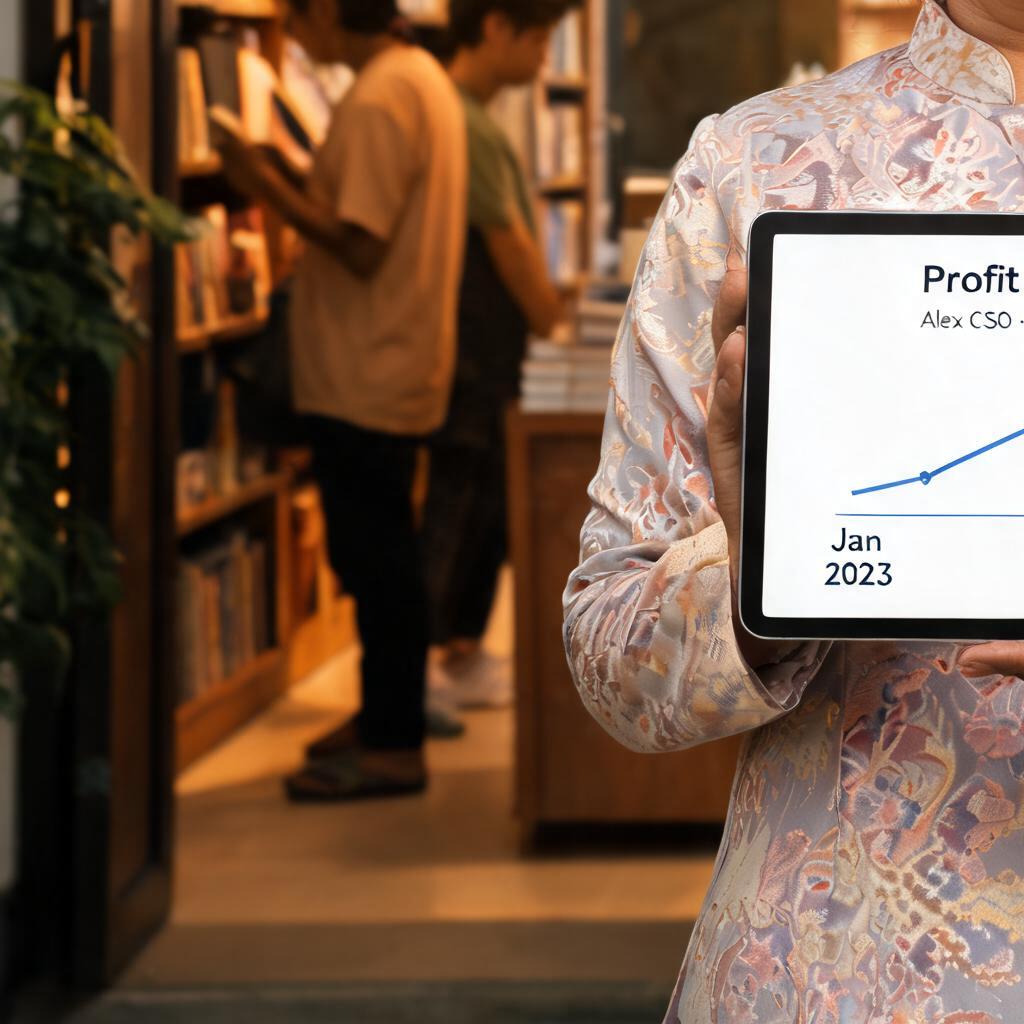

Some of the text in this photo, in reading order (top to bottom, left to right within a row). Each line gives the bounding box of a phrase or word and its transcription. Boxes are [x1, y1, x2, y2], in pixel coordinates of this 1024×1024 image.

[923, 264, 1020, 294] Profit
[920, 309, 963, 329] Alex
[969, 310, 1012, 330] CSO
[831, 527, 881, 553] Jan
[824, 561, 893, 587] 2023
